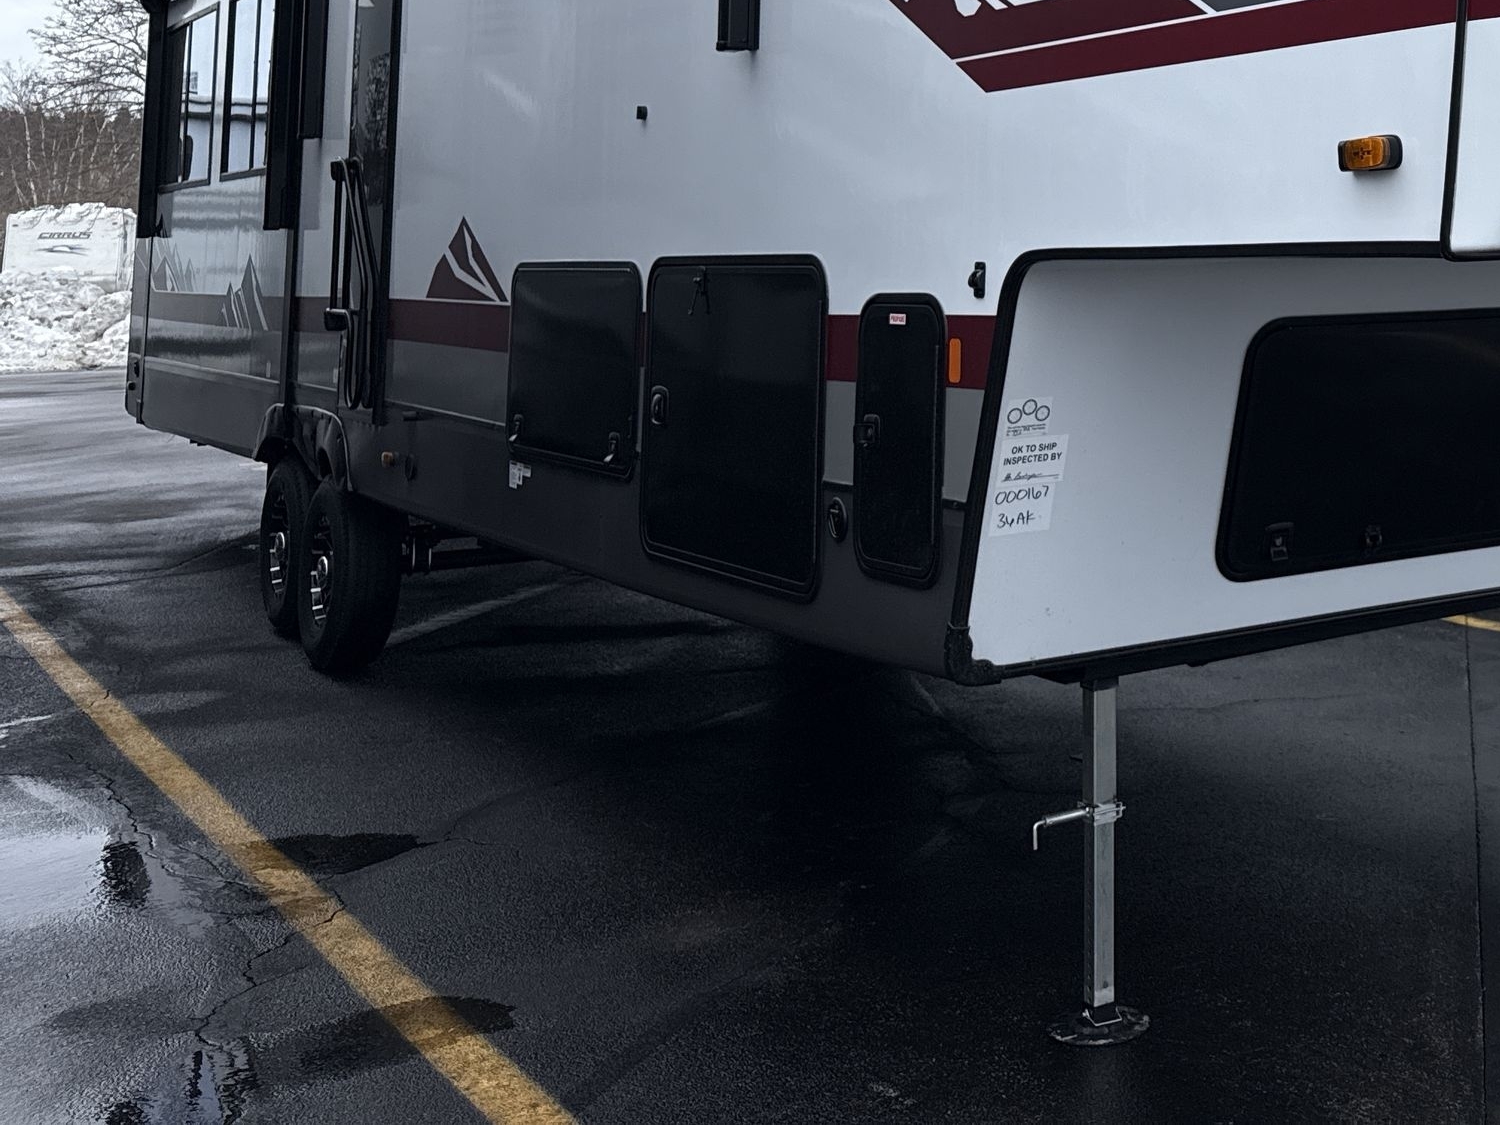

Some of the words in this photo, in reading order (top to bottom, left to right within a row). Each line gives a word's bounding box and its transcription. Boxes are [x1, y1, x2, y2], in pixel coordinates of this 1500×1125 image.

[37, 230, 93, 241] CIRRUS
[1011, 445, 1024, 455] OK
[1025, 443, 1037, 454] TO
[1038, 441, 1058, 453] SHIP
[1003, 452, 1049, 466] INSPECTED
[1050, 451, 1063, 462] BY
[994, 484, 1050, 506] 000167
